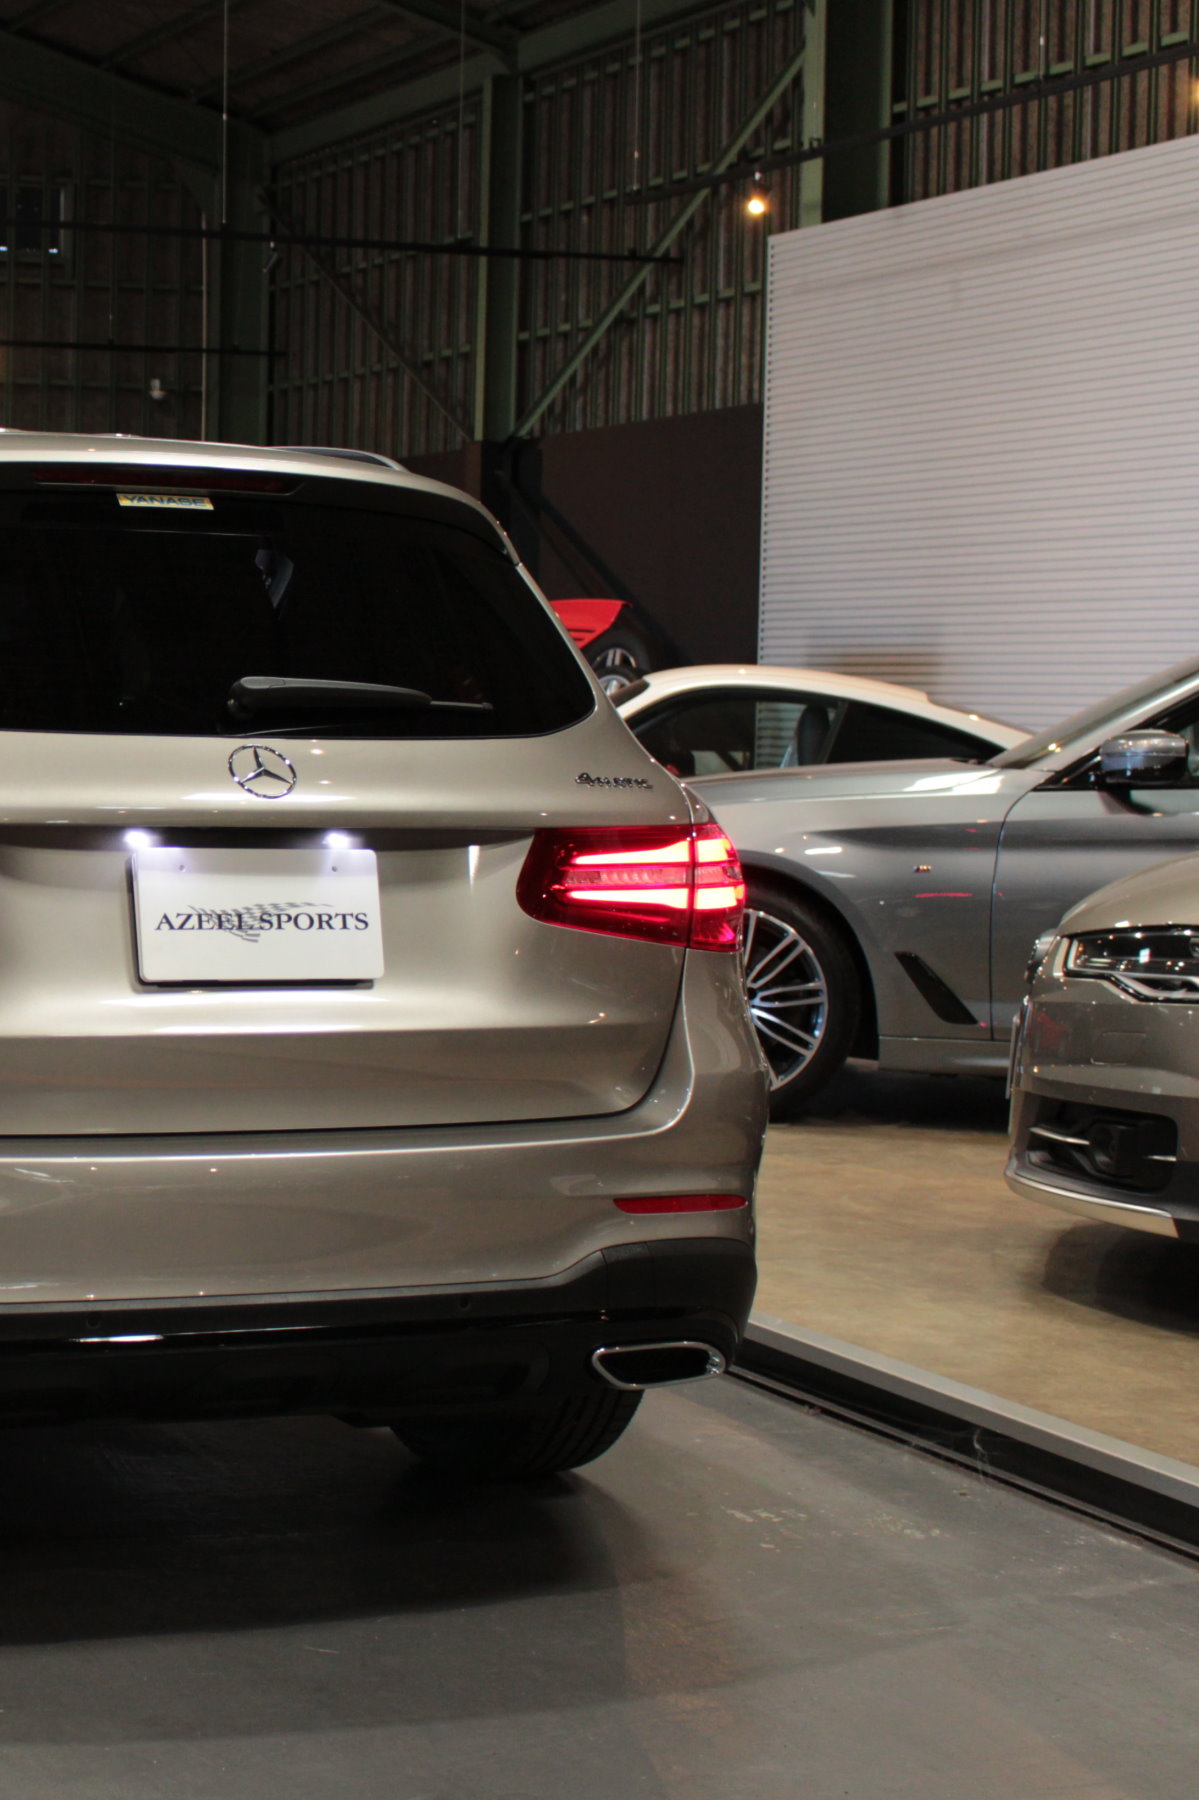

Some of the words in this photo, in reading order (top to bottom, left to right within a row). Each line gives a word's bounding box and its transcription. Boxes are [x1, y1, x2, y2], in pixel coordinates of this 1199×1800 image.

[122, 494, 208, 507] YANASE
[155, 912, 254, 931] AZEEL
[259, 912, 369, 931] SPORTS
